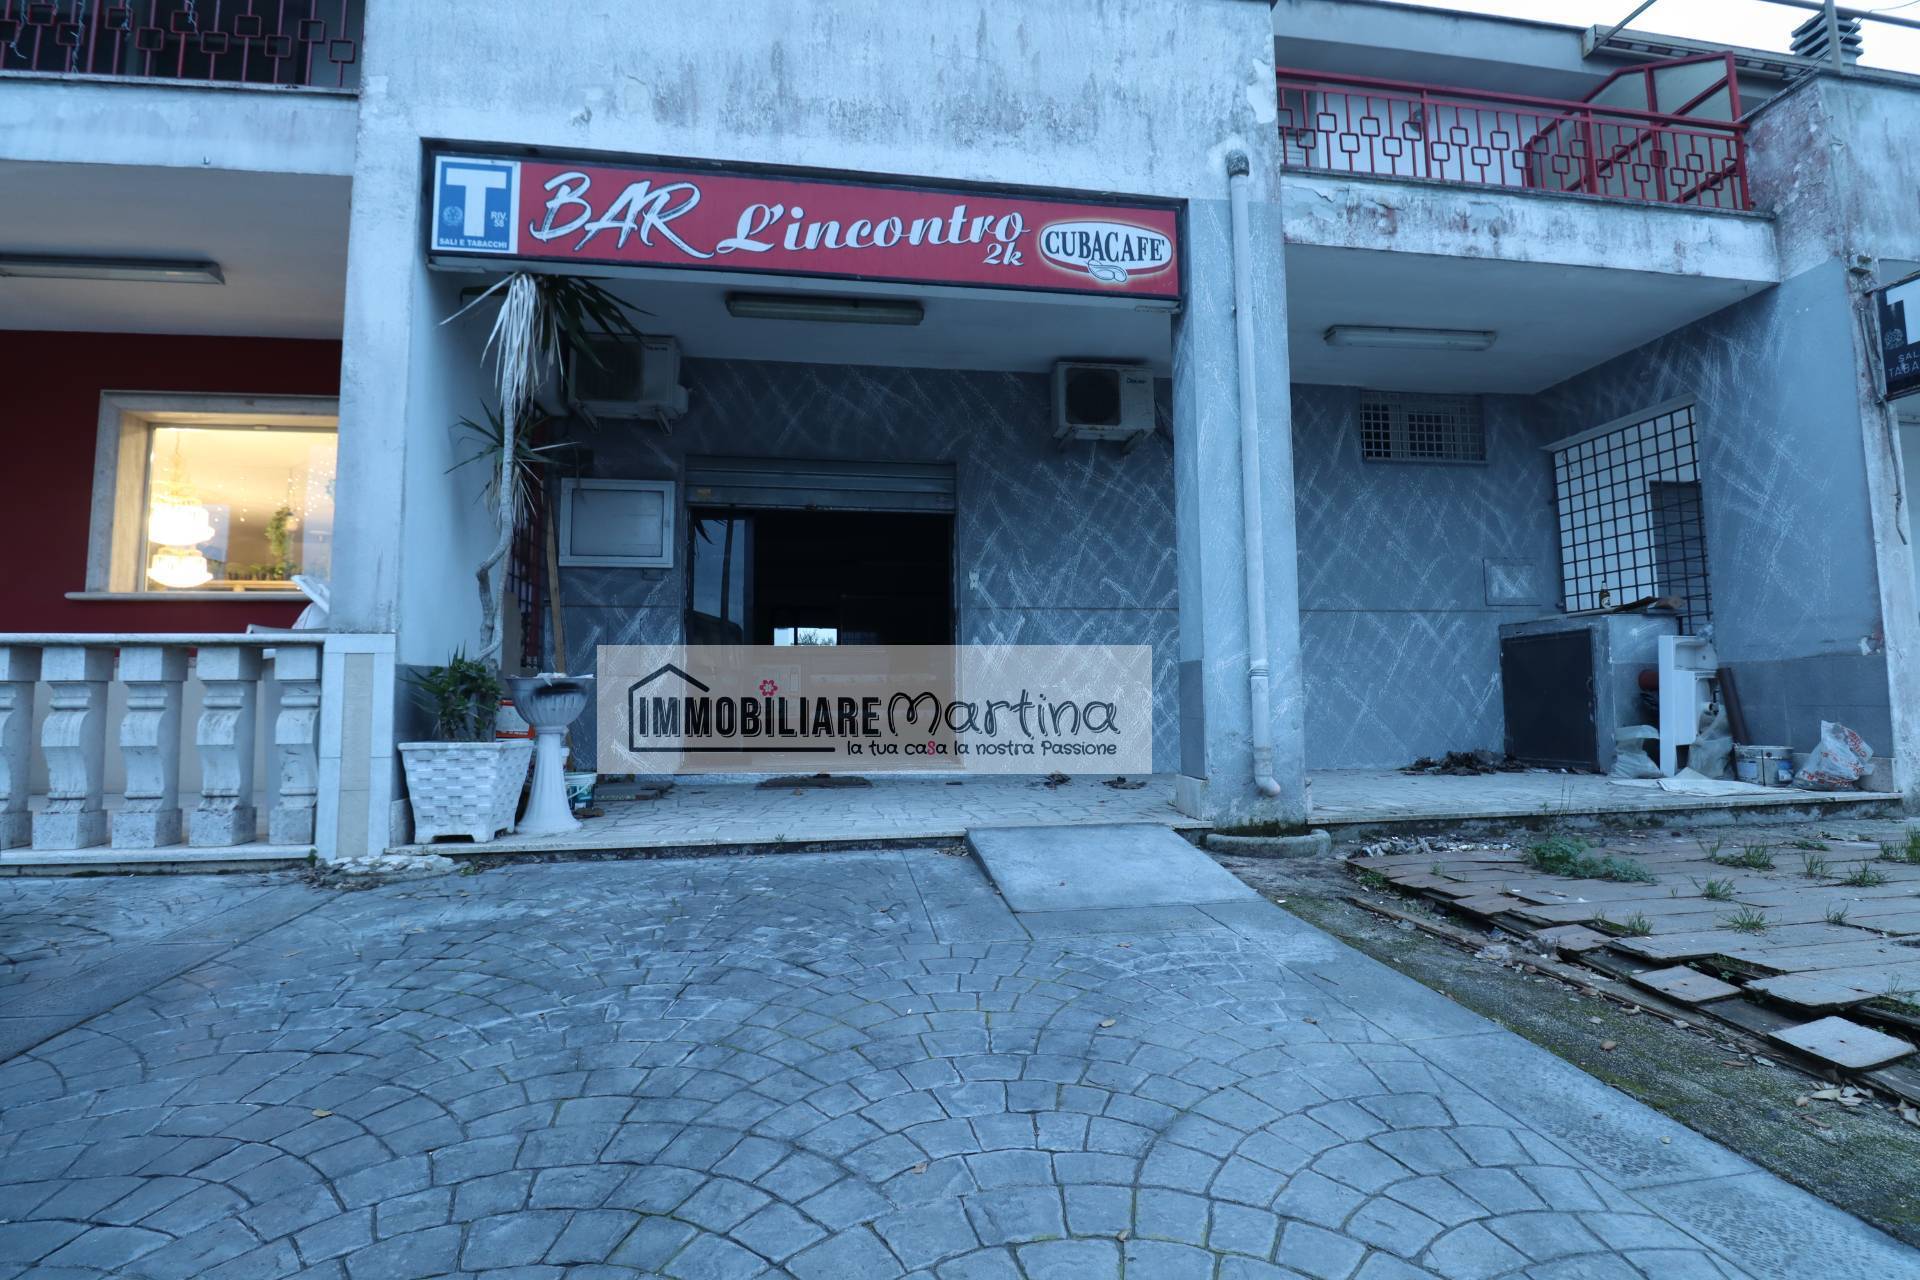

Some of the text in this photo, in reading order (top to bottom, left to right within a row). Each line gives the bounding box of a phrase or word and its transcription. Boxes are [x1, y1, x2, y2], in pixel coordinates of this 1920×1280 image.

[446, 168, 507, 237] T
[530, 172, 715, 259] BAR
[439, 238, 458, 246] SALI
[467, 239, 508, 249] TABACCHI
